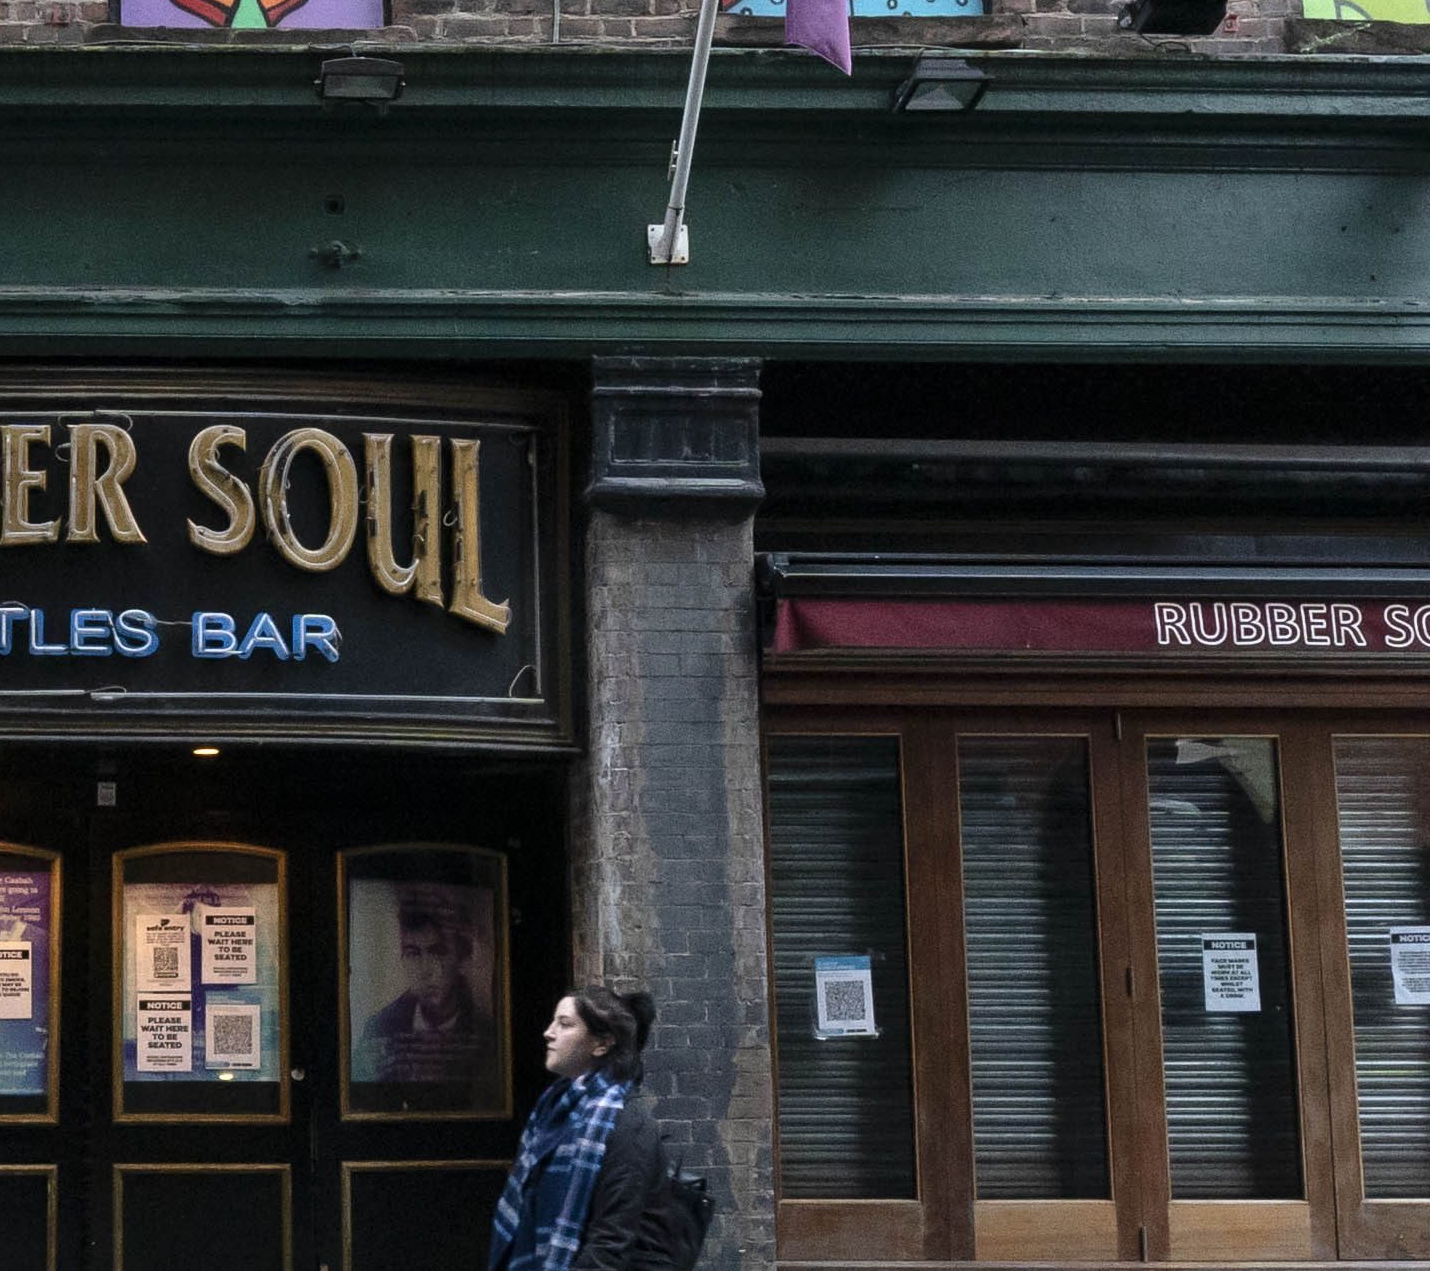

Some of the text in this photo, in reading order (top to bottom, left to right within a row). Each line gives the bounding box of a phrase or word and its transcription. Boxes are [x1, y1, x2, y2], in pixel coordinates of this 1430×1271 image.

[186, 425, 512, 635] SOUL
[191, 611, 340, 662] BAR
[1154, 602, 1367, 647] RUBBER
[1211, 941, 1247, 949] NOTICE
[147, 1002, 183, 1010] NOTICE
